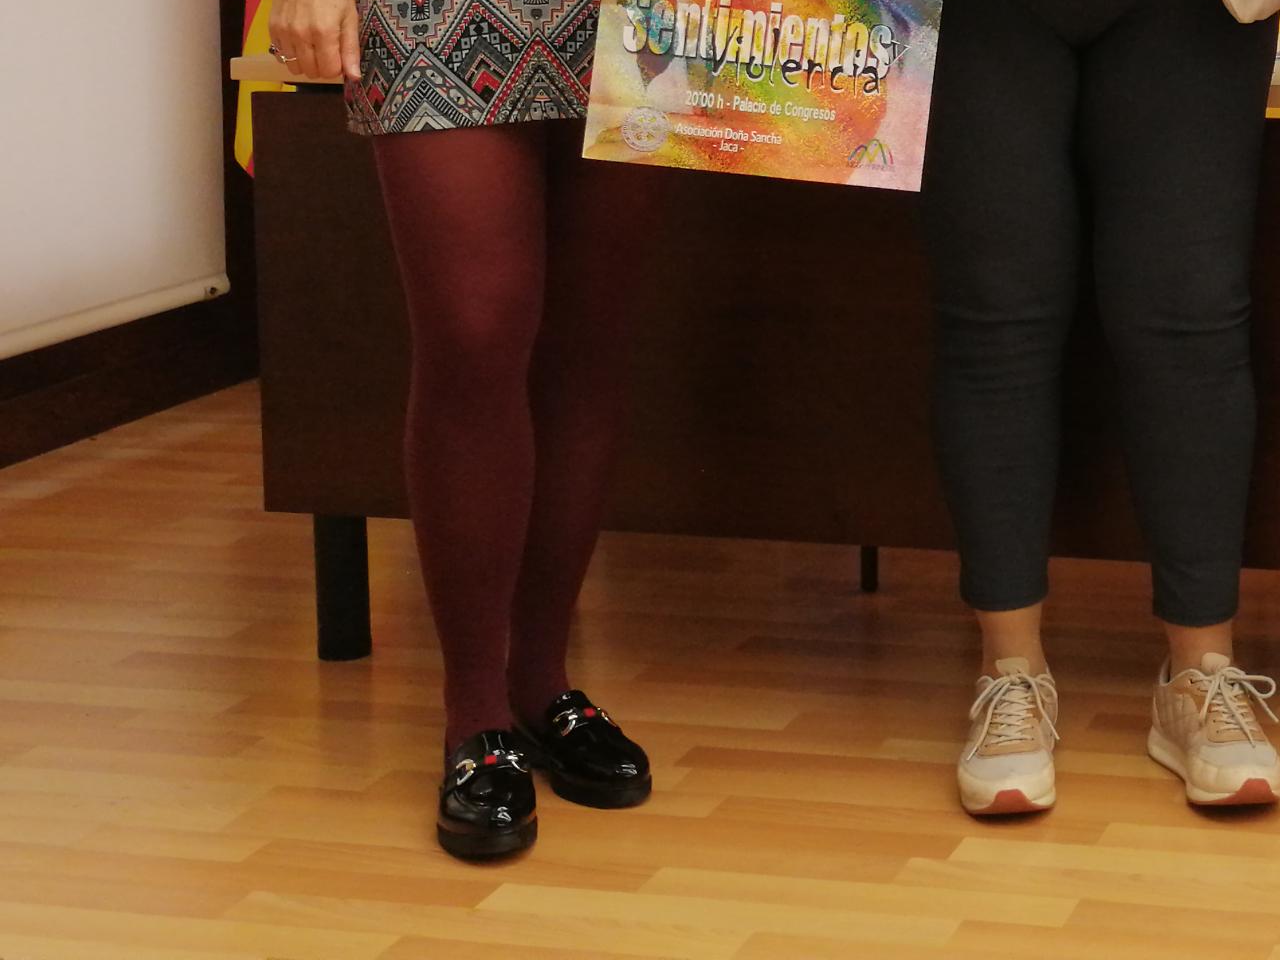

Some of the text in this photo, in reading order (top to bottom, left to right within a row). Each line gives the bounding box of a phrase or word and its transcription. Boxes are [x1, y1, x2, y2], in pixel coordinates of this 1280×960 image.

[717, 93, 724, 109] h
[733, 96, 767, 114] Palacio
[769, 100, 782, 116] de
[784, 101, 837, 122] Congresos
[675, 123, 782, 145] Asociación Doña Sancha
[719, 141, 739, 153] Jaca
